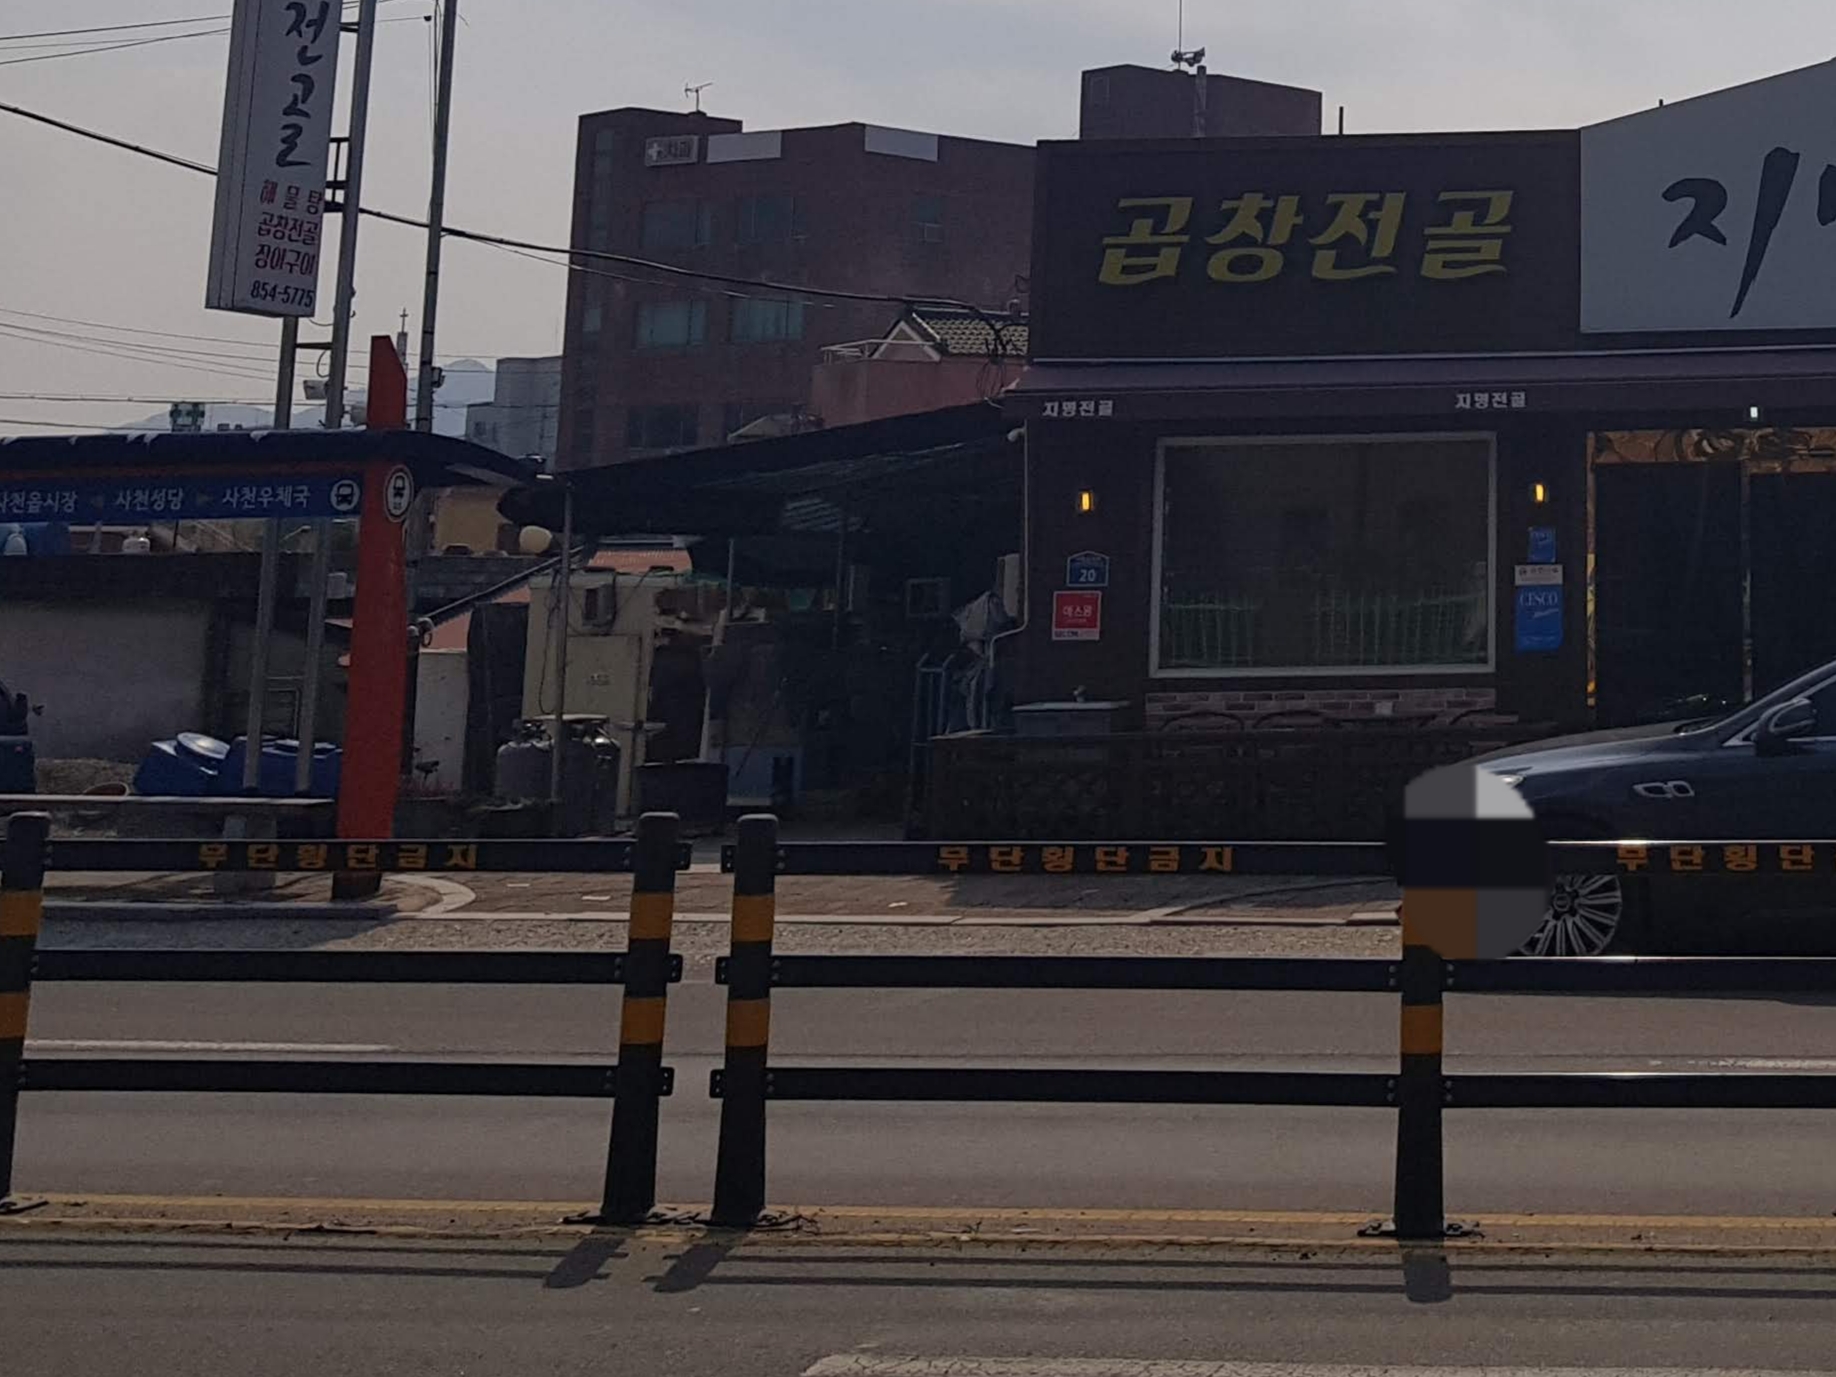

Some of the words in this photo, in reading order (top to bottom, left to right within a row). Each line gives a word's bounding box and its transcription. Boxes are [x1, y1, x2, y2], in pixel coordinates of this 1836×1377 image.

[257, 211, 319, 246] 곱창전골
[1097, 190, 1515, 286] 곱창전골
[250, 279, 316, 308] 854-5775
[1041, 399, 1114, 418] 지명전골
[1454, 391, 1527, 410] 지명전골
[115, 487, 184, 511] 사천성당
[222, 484, 312, 509] 사천우체국
[1078, 568, 1097, 582] 20
[937, 845, 1234, 872] 무단횡단금지
